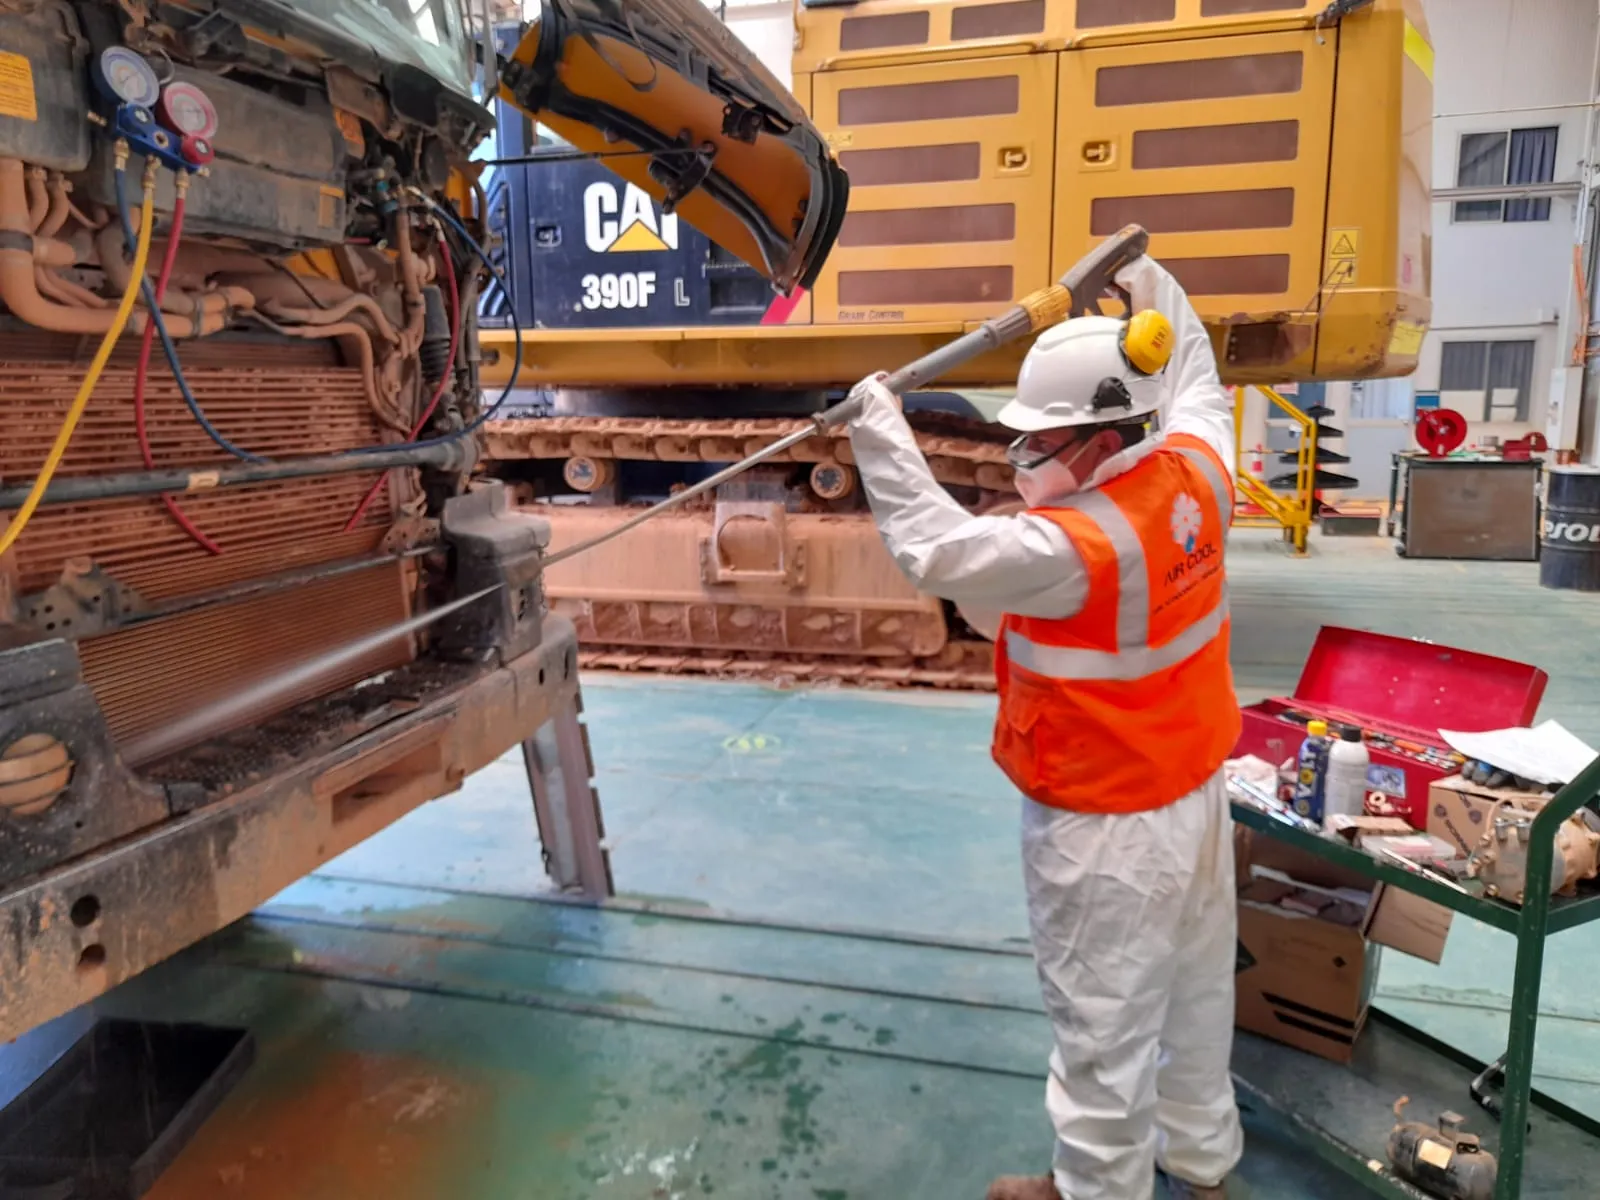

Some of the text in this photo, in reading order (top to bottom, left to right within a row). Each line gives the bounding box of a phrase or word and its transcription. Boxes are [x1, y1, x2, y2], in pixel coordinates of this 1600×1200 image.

[581, 271, 691, 310] 390F L
[1187, 543, 1217, 570] COOL
